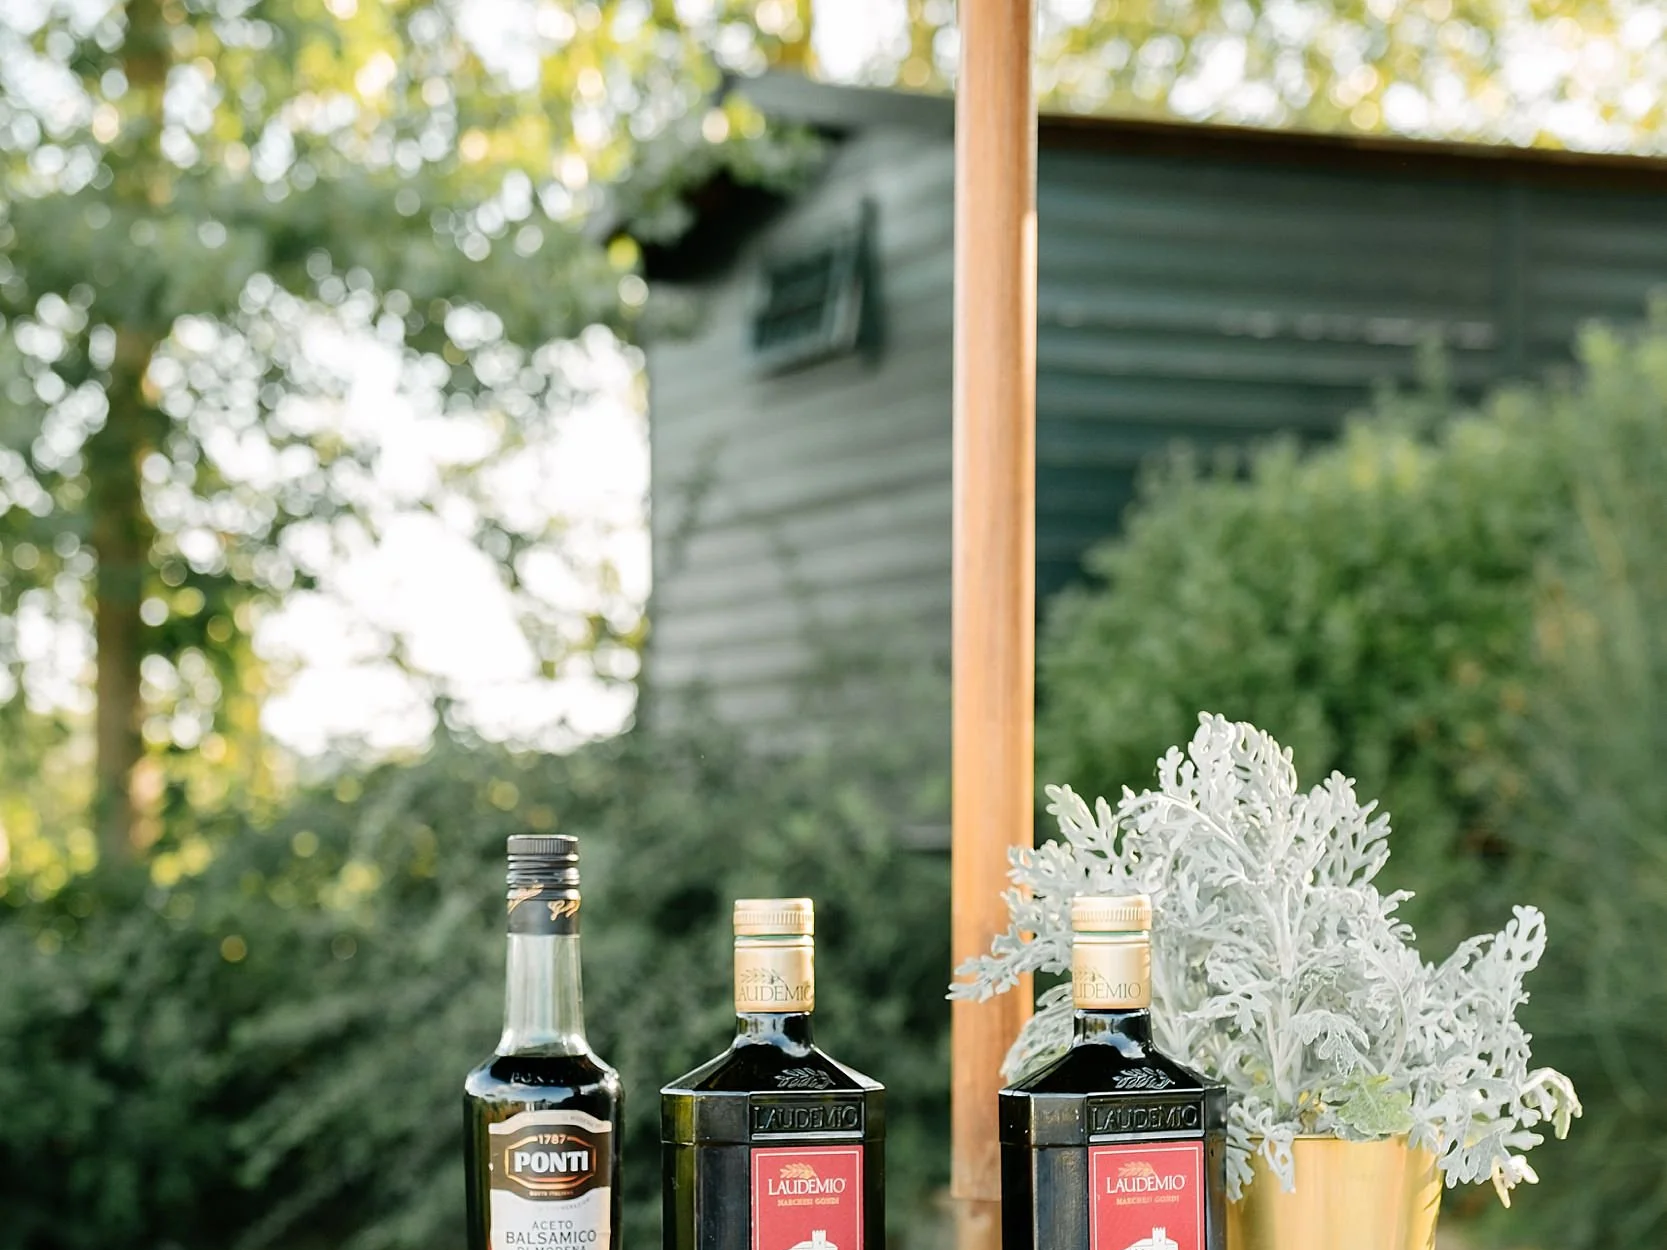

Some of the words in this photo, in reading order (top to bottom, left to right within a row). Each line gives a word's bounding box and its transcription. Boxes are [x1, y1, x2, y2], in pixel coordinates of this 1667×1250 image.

[753, 1105, 858, 1129] LAUDEMIO
[1092, 1105, 1198, 1130] LAUDEMIO
[538, 1134, 567, 1145] 1787
[514, 1150, 589, 1173] PONTI
[768, 1177, 845, 1196] LAUDEMIO
[1106, 1174, 1185, 1194] LAUDEMIO
[532, 1220, 574, 1231] ACETO
[506, 1230, 597, 1245] BALSAMICO
